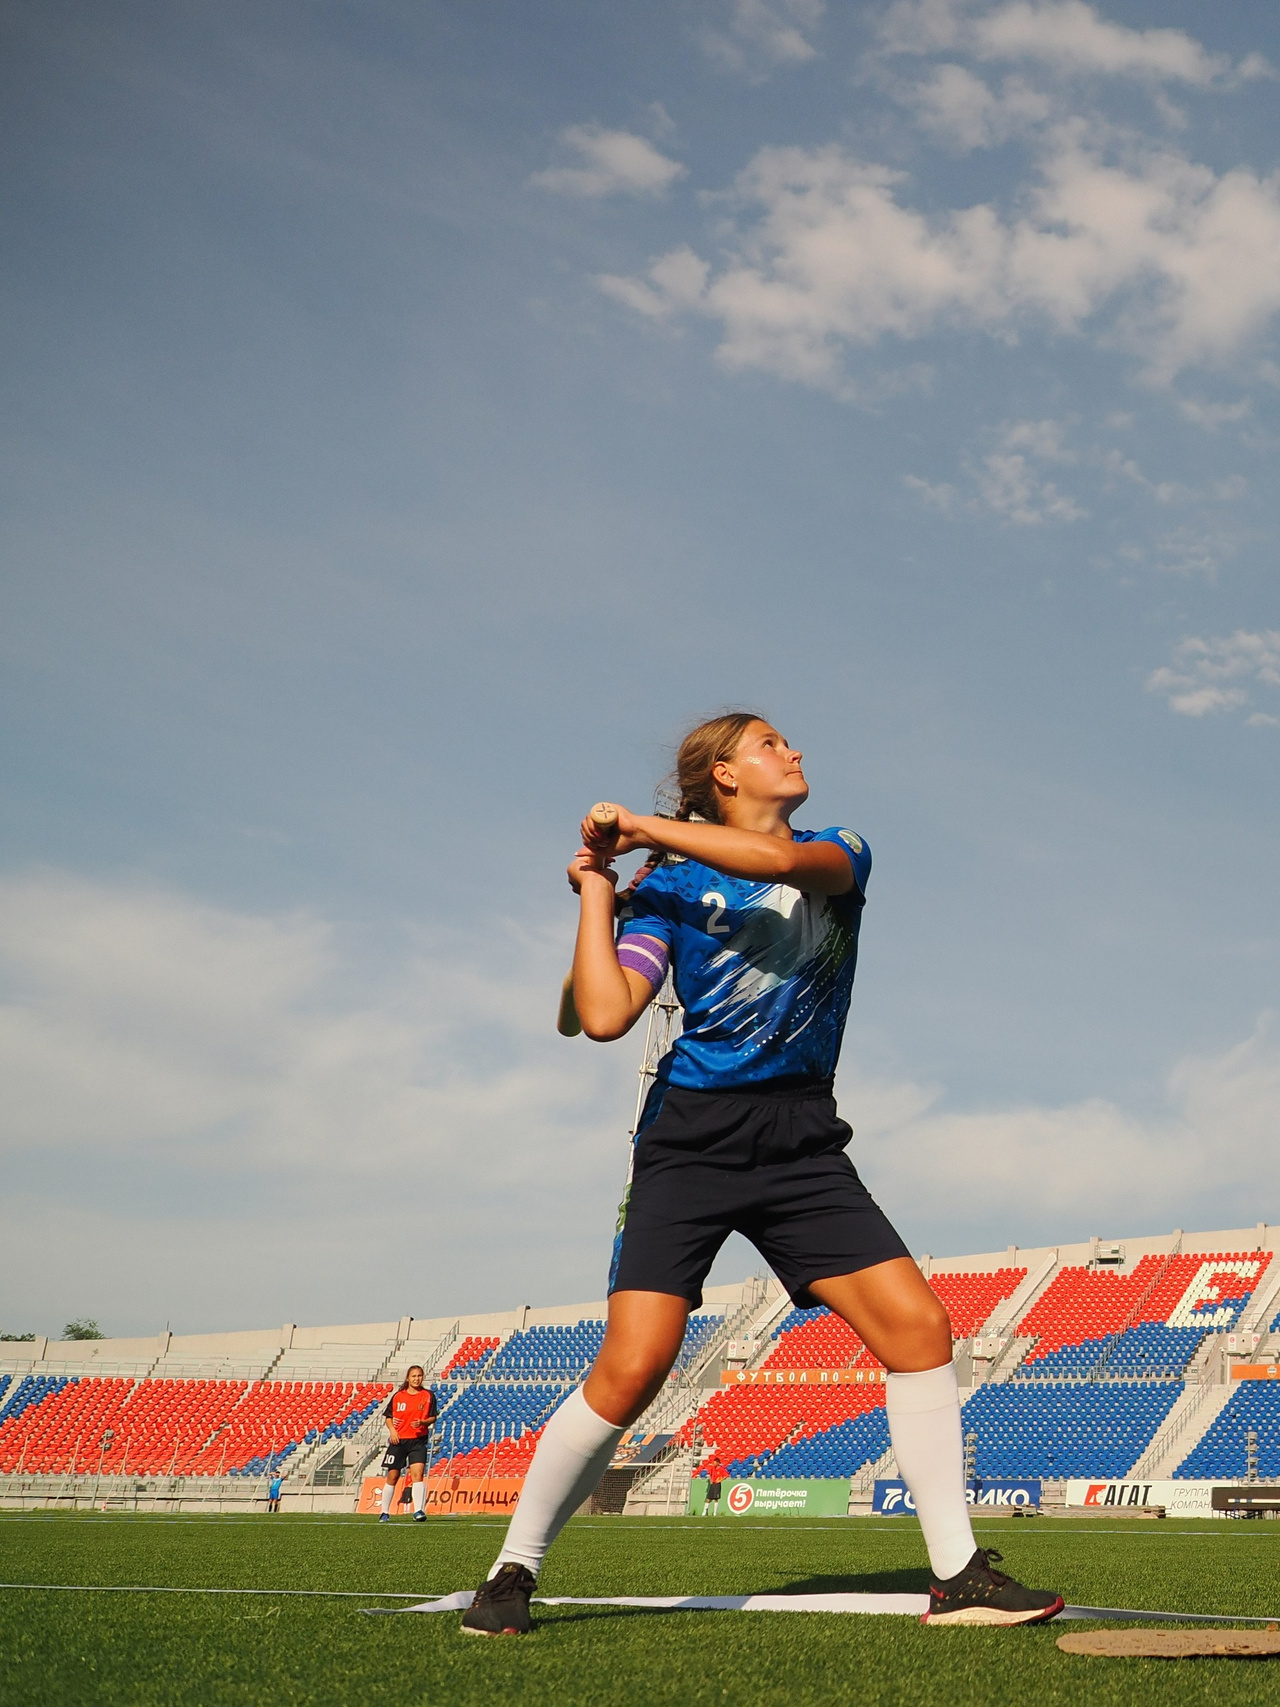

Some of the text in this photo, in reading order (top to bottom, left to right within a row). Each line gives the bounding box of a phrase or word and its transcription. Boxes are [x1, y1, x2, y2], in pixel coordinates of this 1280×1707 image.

[701, 891, 731, 935] 2
[736, 1372, 887, 1383] ФУТБОЛ ПО-НОВ
[396, 1402, 406, 1412] 10
[384, 1454, 395, 1465] 10
[454, 1490, 520, 1506] ПИЦЦА
[734, 1486, 748, 1507] 5
[755, 1488, 807, 1499] Пятёрочка
[1104, 1485, 1152, 1506] АГАТ
[1173, 1488, 1209, 1497] ГРУППА
[754, 1499, 806, 1509] выручает!
[1171, 1500, 1212, 1509] КОМПАН
